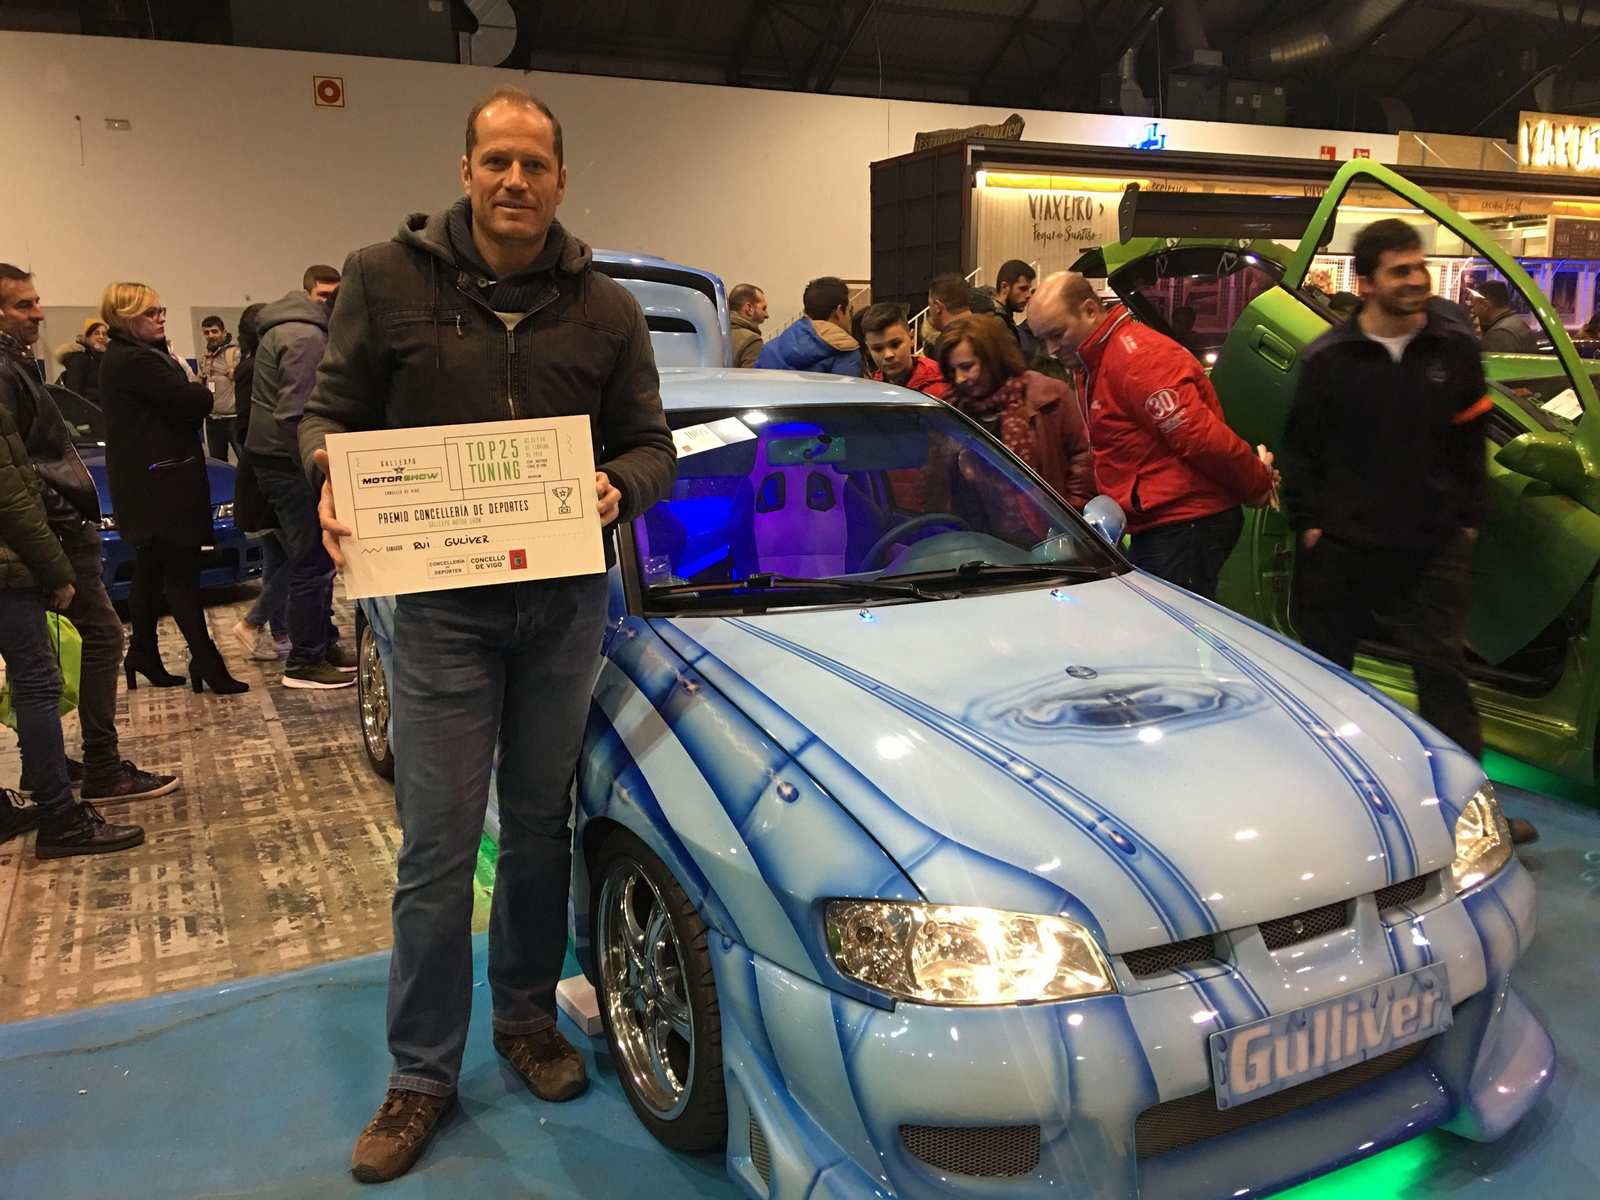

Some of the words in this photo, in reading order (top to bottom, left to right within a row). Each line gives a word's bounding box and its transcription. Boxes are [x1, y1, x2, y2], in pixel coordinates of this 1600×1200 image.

[1028, 193, 1093, 221] VIAXEIRO
[1149, 391, 1175, 417] 30
[381, 458, 416, 467] GALIEXPO
[468, 460, 521, 483] TUNING
[378, 510, 409, 524] PREMIO
[414, 504, 469, 521] CONCELLERÍA
[473, 504, 484, 516] DE
[488, 500, 529, 514] DEPORTES
[470, 555, 506, 564] CONCELLO
[1229, 990, 1443, 1096] Gulliver
